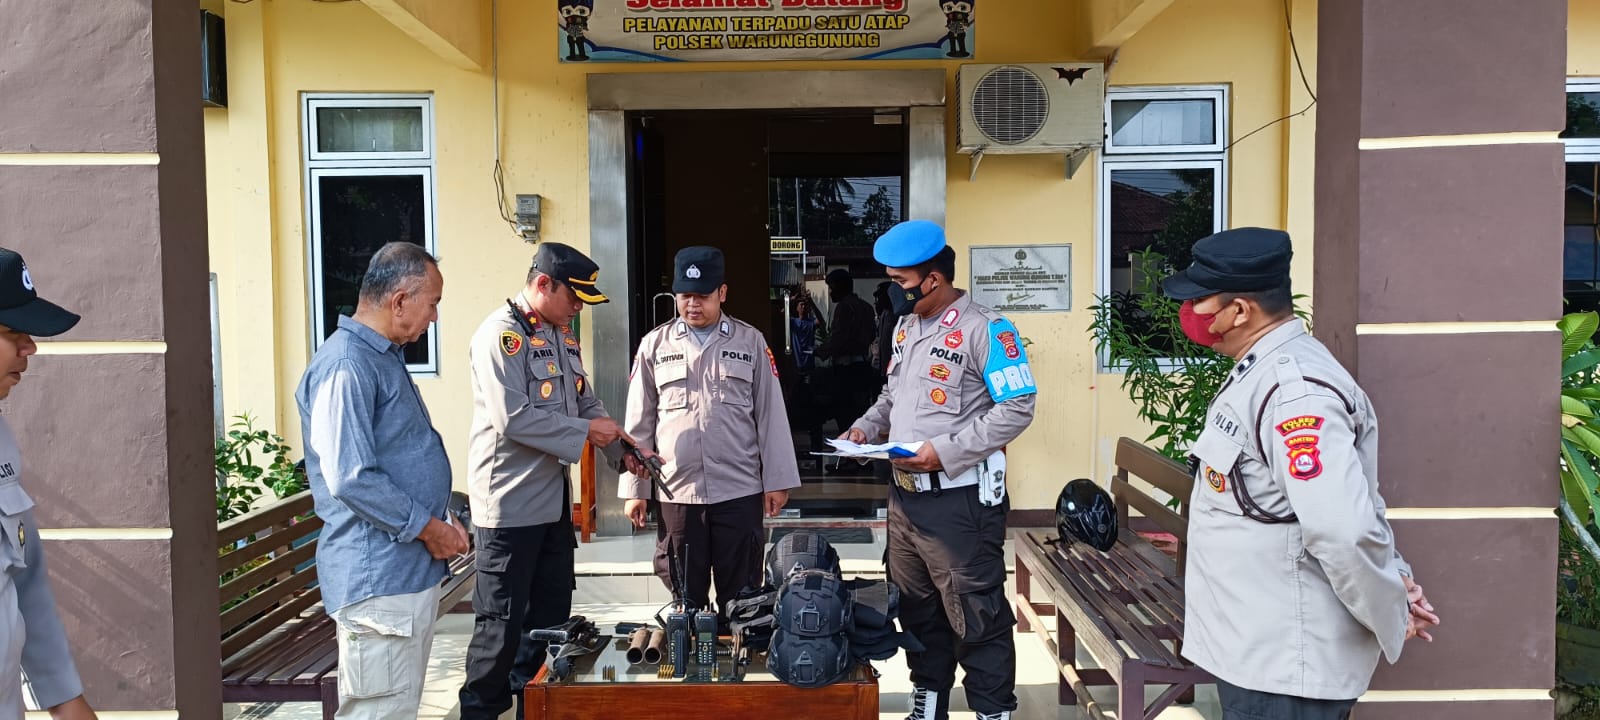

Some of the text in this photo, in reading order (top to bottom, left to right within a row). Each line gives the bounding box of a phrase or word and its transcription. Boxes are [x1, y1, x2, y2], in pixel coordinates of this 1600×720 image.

[623, 14, 910, 32] PELAYANAN TERPADU SATU ATAP
[653, 32, 880, 50] POLSEK WARUNGGUNUNG
[771, 240, 801, 249] DORONG
[532, 348, 554, 359] ARIE
[722, 350, 752, 363] POLRI
[929, 347, 964, 365] POLRI
[988, 361, 1034, 397] PRO
[1288, 436, 1315, 445] BANTEN
